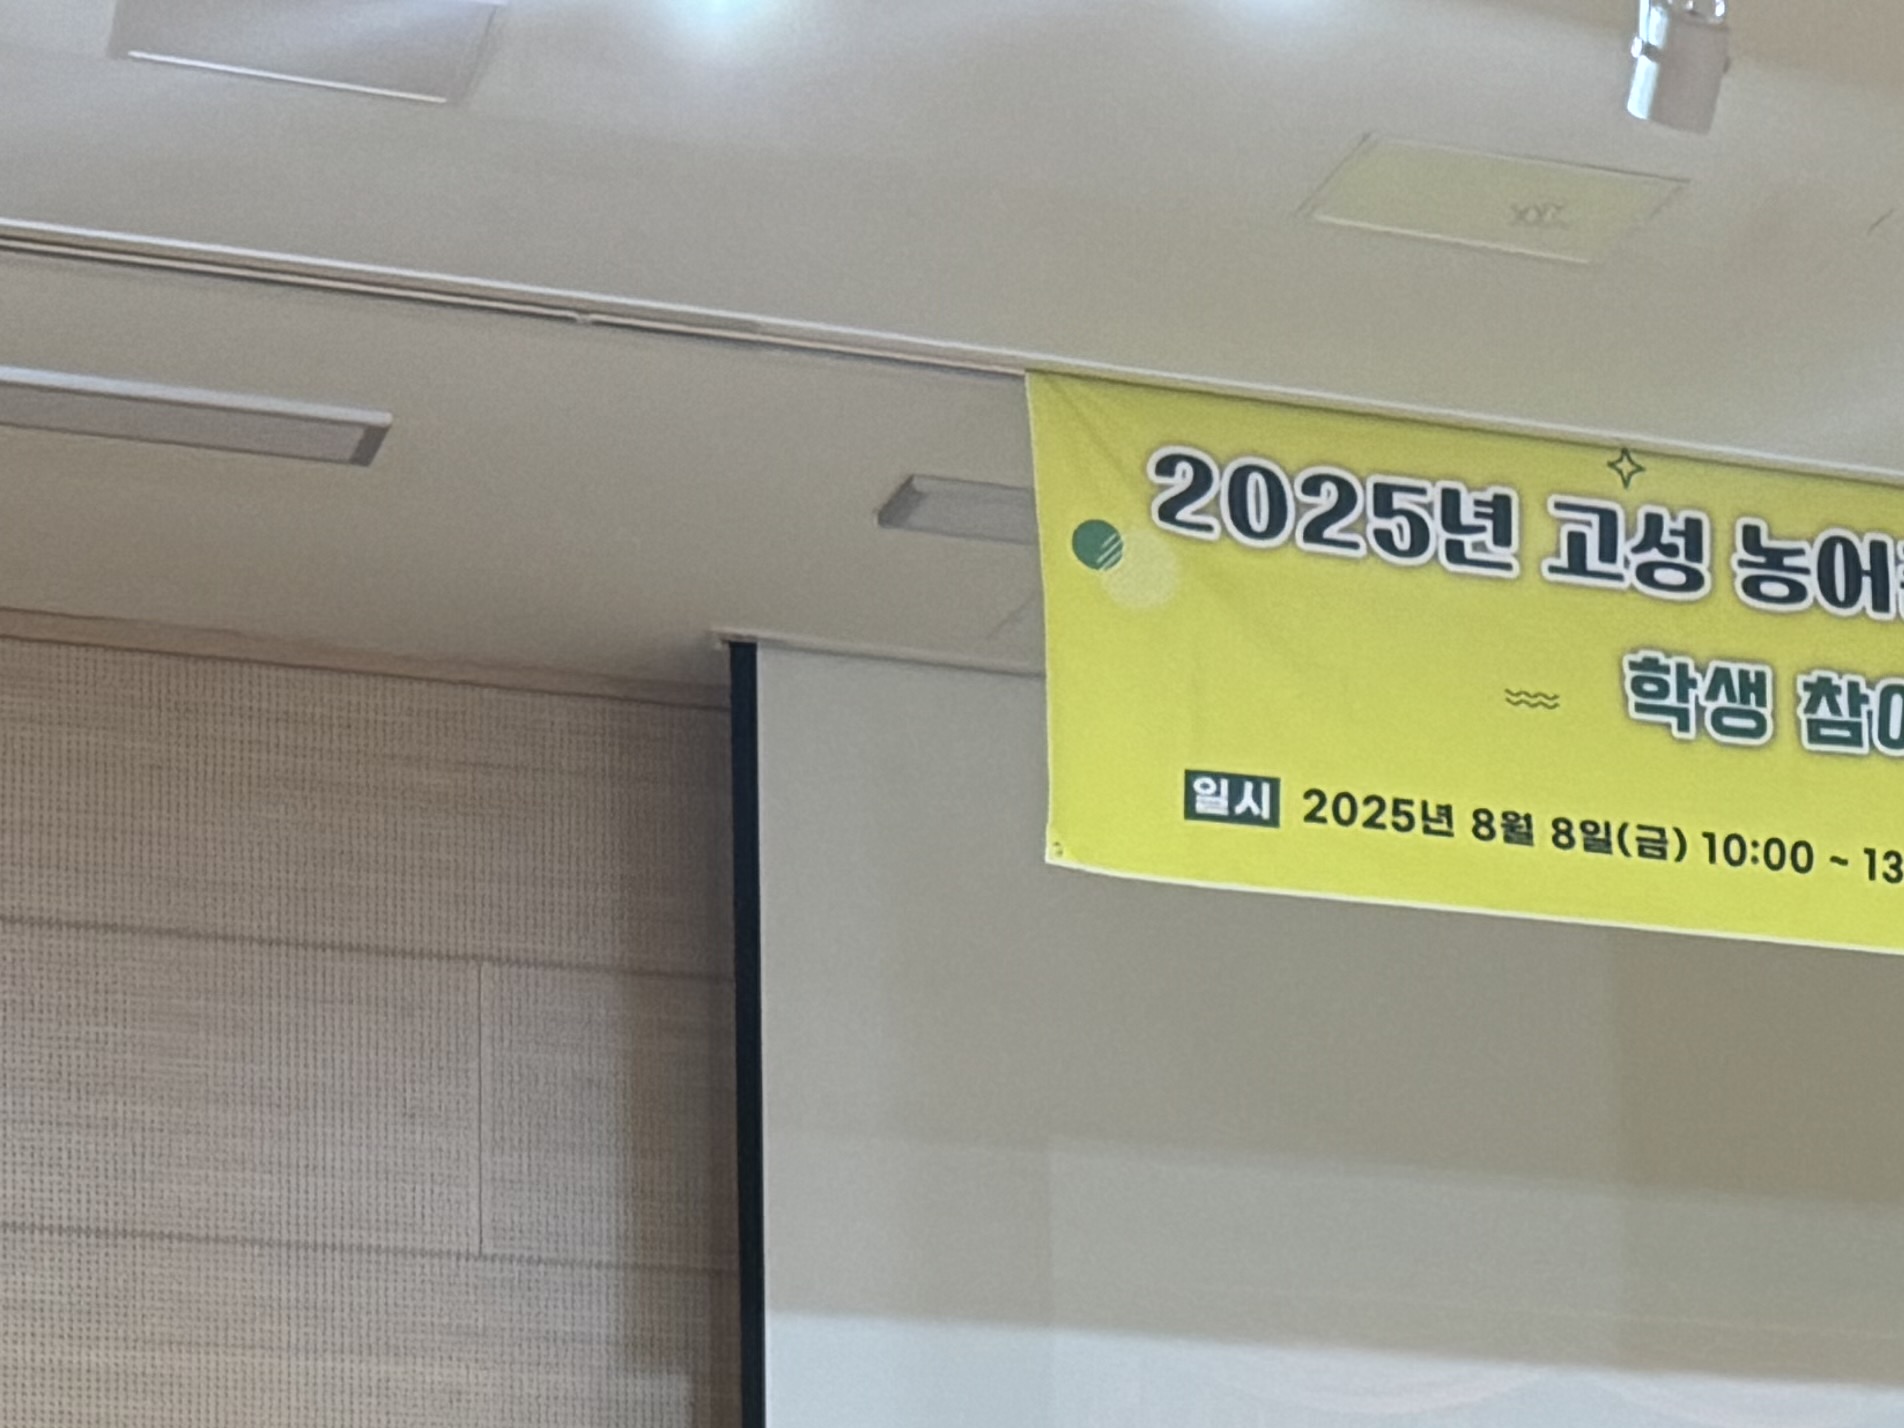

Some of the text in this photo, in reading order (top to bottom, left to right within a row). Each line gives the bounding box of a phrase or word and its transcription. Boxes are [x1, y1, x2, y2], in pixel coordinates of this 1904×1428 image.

[1151, 450, 1516, 574] 2025년
[1545, 499, 1708, 595] 고성
[1625, 654, 1770, 742] 학생
[1191, 776, 1274, 819] 일시
[1302, 787, 1456, 839] 2025년
[1470, 806, 1535, 848] 8월
[1550, 815, 1688, 864] 8일(금)
[1700, 830, 1815, 875] 10:00
